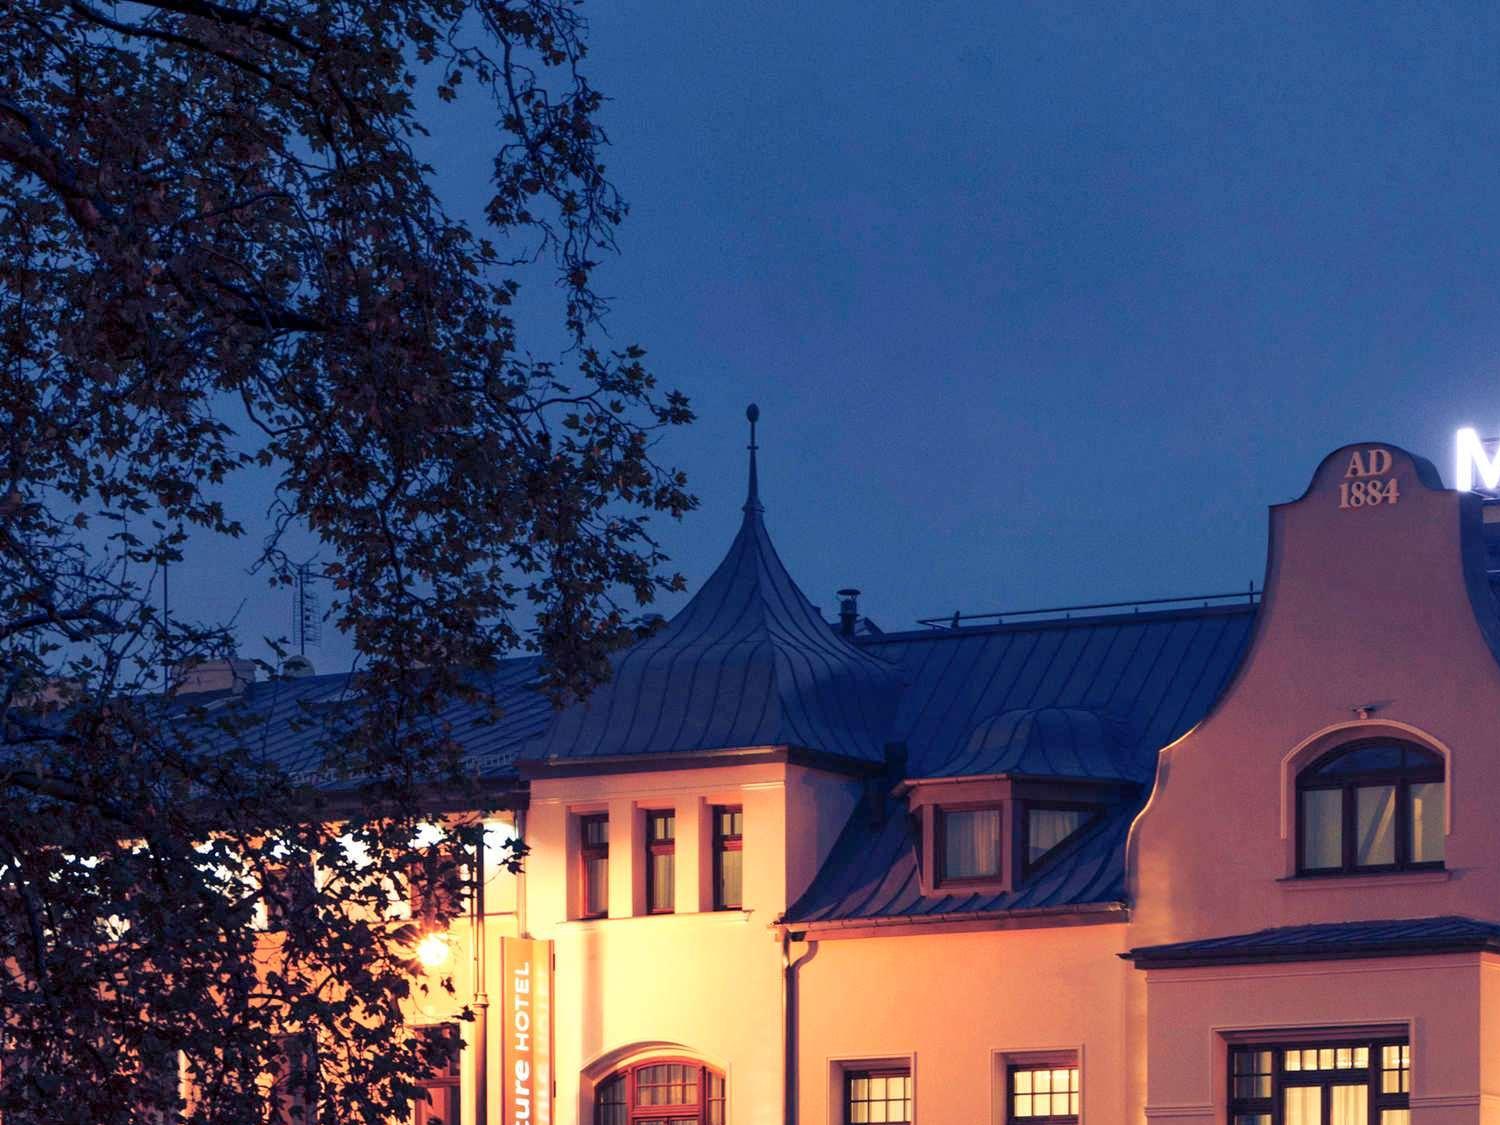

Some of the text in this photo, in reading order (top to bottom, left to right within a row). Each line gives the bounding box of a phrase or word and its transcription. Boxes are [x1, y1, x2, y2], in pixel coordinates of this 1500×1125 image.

[1344, 449, 1393, 478] AD
[1338, 478, 1400, 509] 1884
[514, 961, 529, 1051] HOTEL
